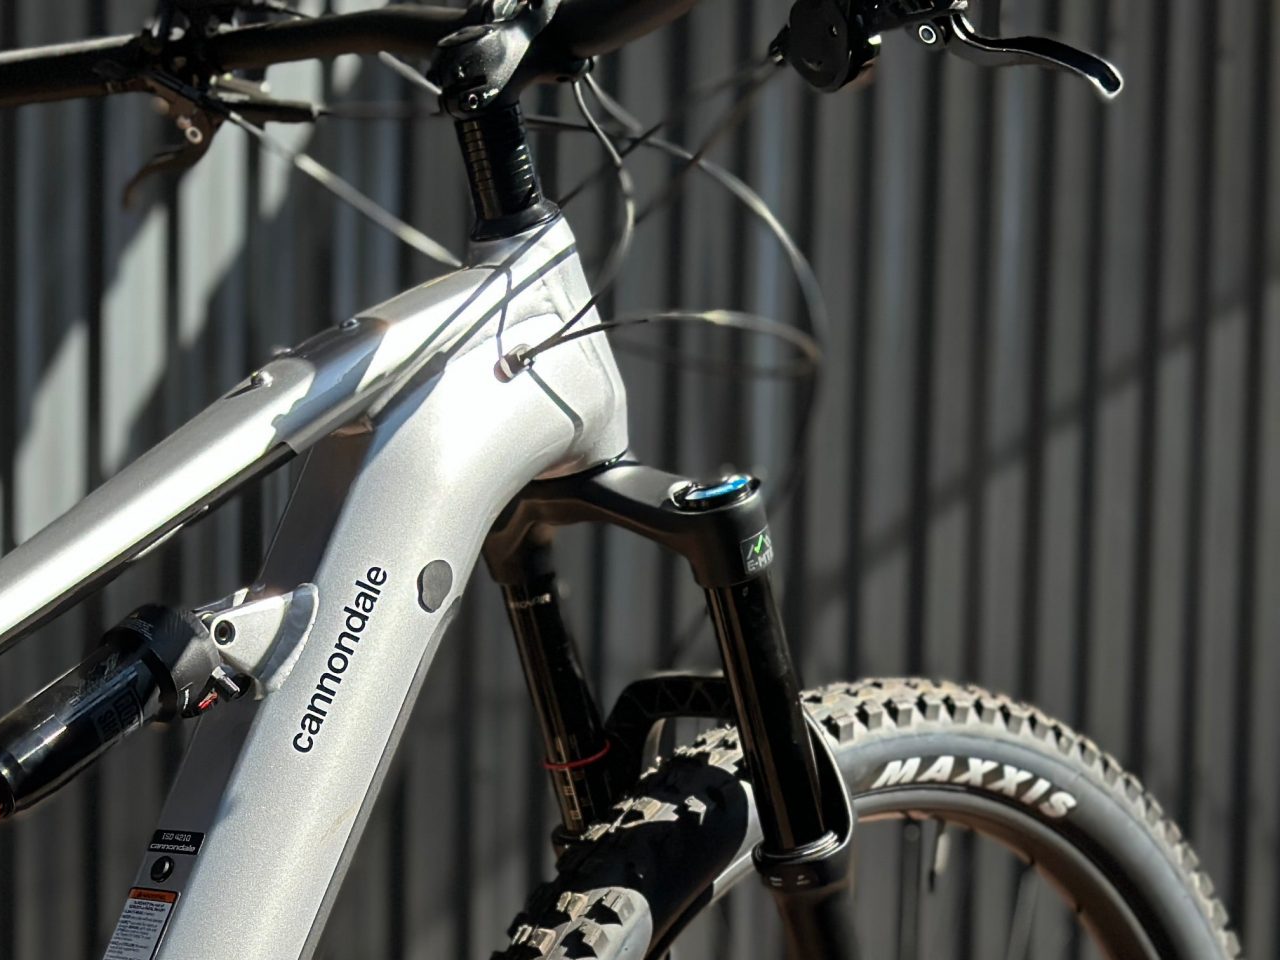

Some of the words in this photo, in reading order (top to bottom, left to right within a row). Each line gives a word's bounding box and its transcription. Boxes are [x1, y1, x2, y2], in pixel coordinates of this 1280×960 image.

[293, 566, 388, 753] cannondale
[871, 755, 1078, 818] MAXXIS
[150, 843, 196, 852] cannondale
[161, 832, 175, 841] ISO
